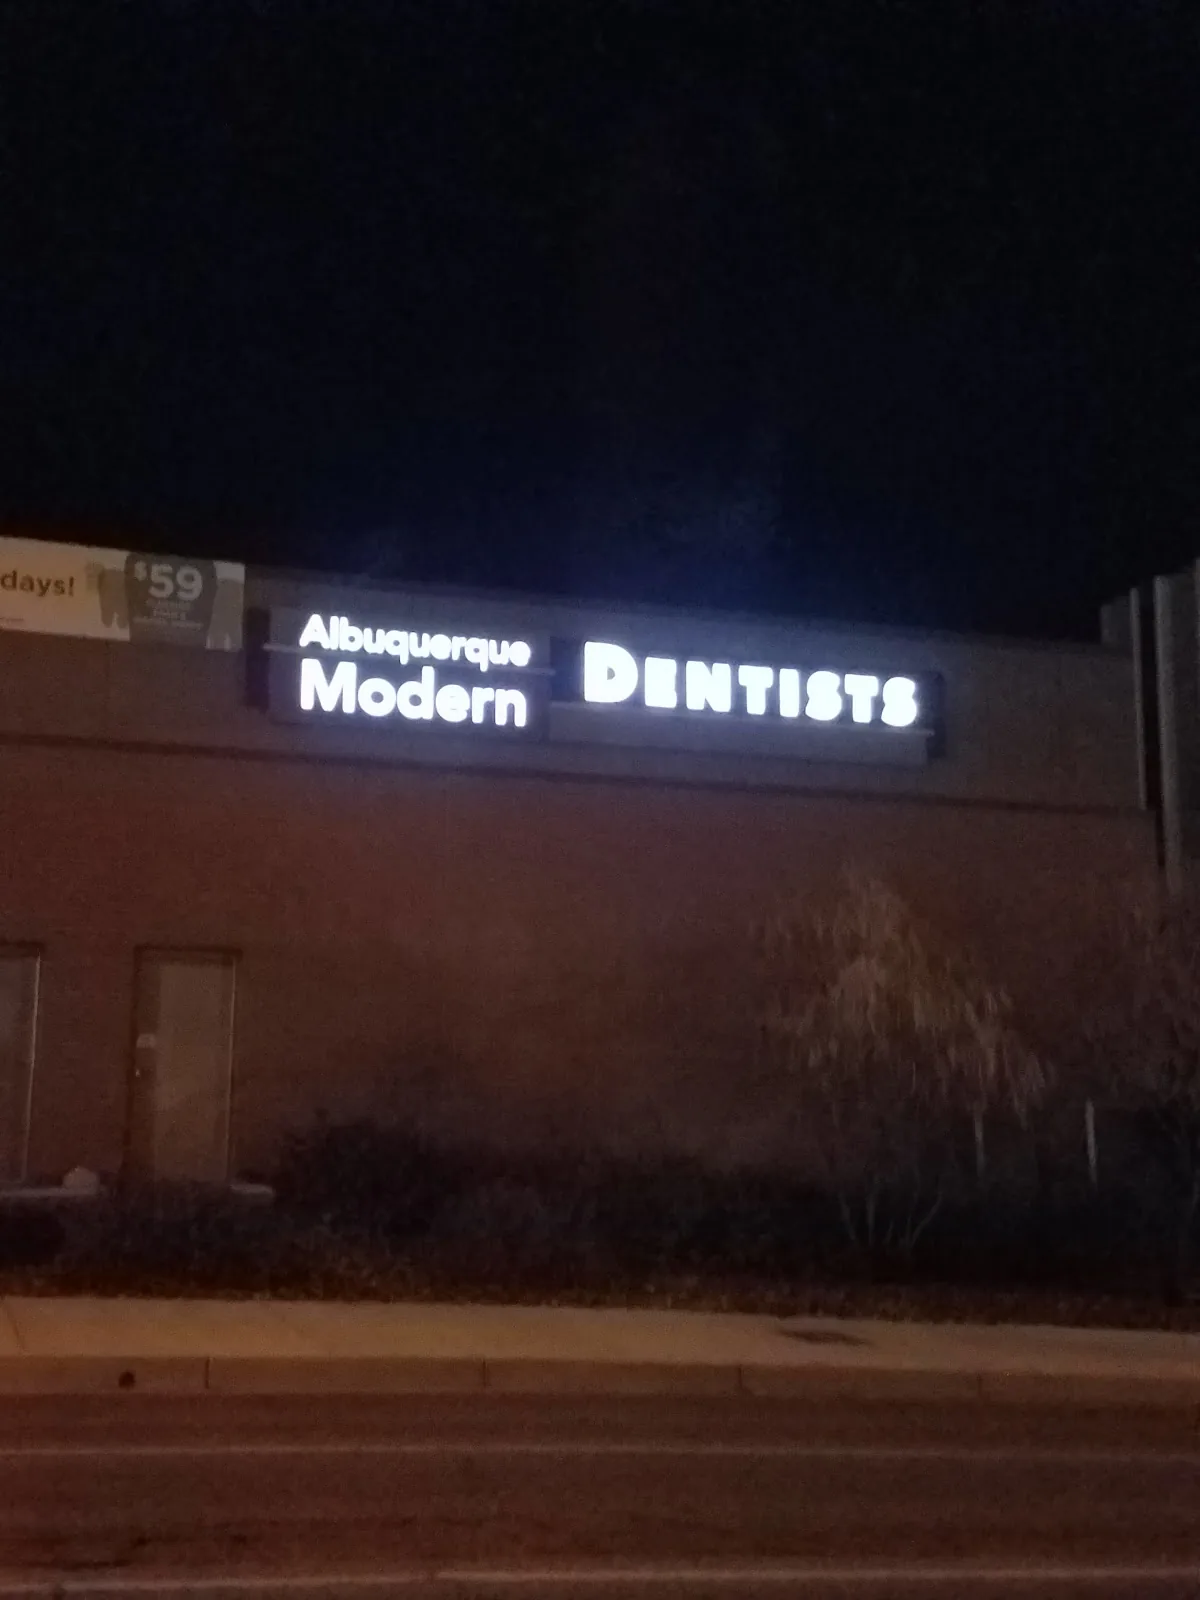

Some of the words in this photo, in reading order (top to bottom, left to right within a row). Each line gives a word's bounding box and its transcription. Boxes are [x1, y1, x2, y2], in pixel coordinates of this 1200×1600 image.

[0, 570, 75, 597] days!
[299, 613, 532, 672] Albuquerque
[299, 657, 528, 729] Modern
[583, 641, 920, 728] DENTISTS
